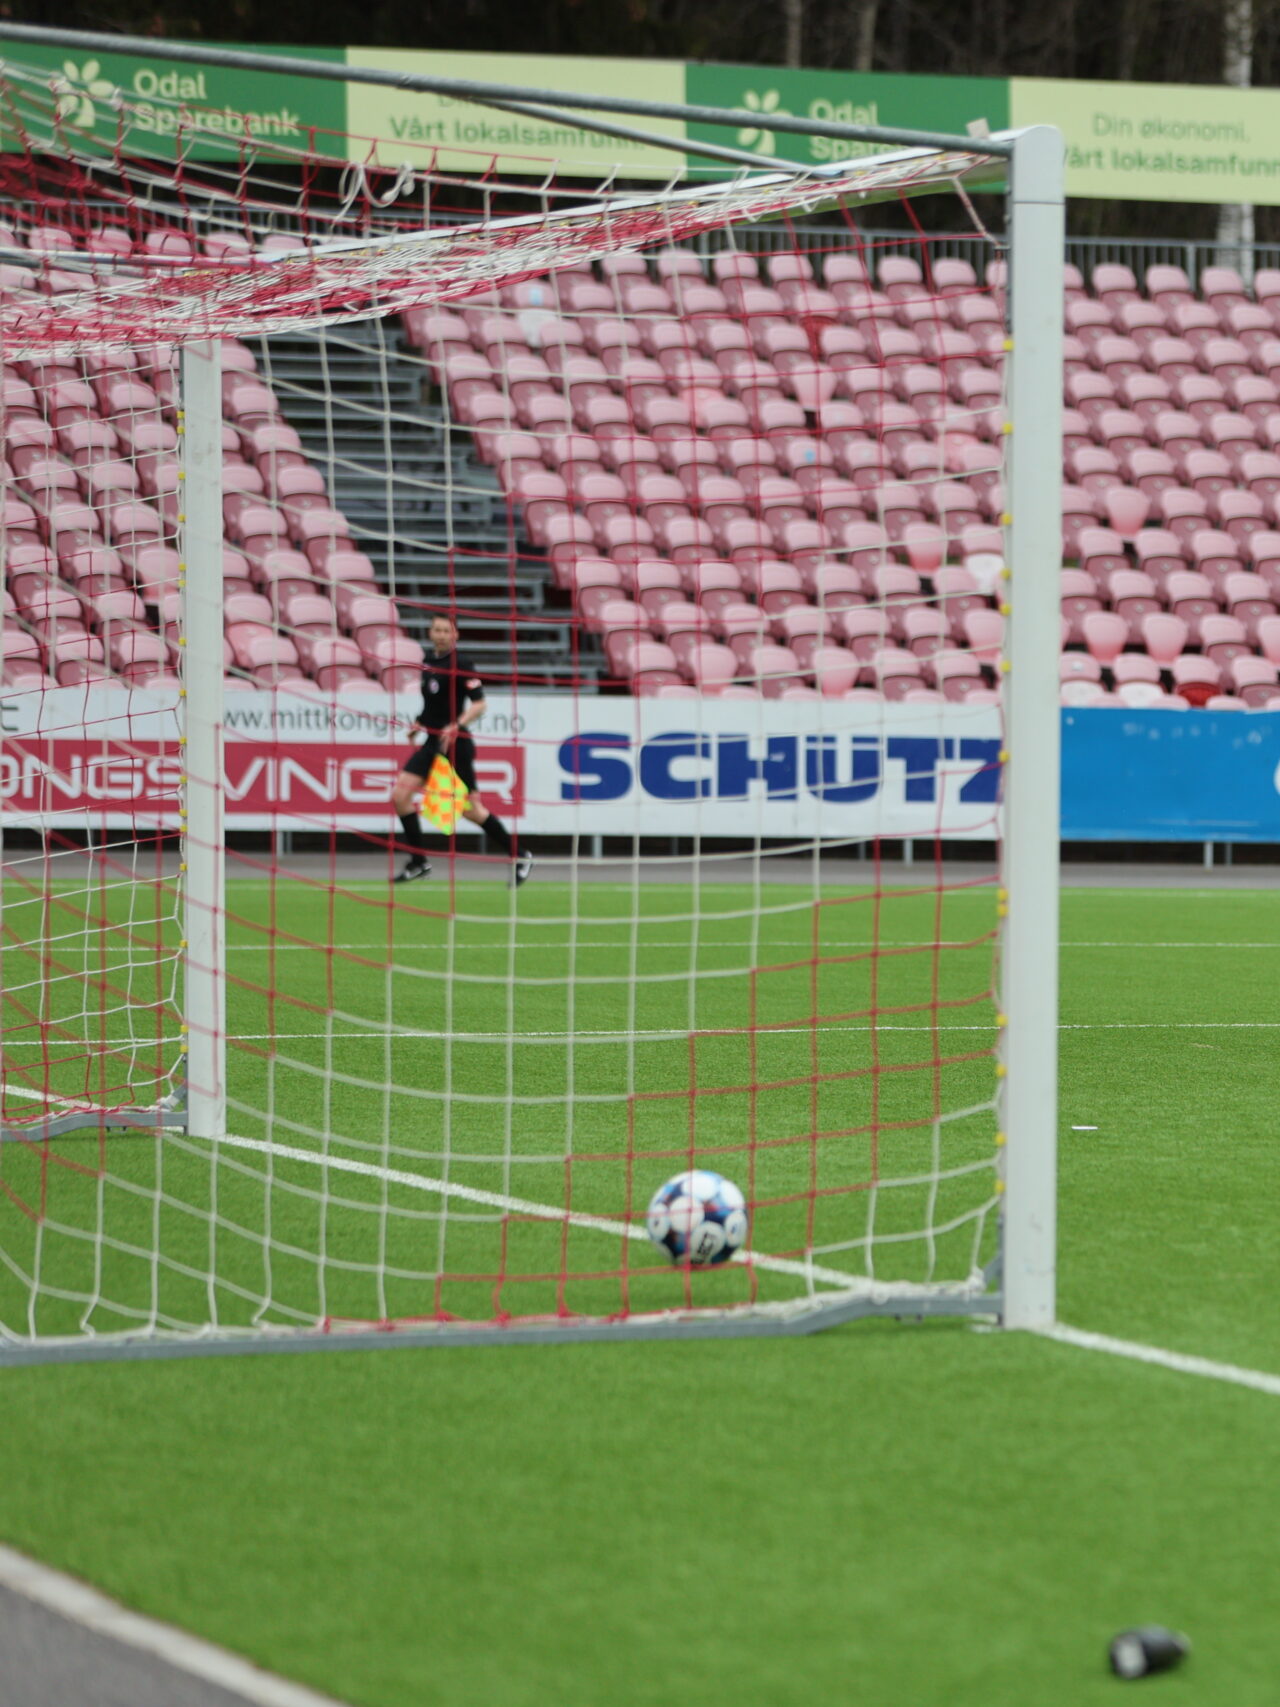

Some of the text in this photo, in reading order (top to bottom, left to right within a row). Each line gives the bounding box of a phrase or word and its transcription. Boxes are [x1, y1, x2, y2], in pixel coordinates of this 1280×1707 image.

[133, 69, 208, 99] Odal
[134, 102, 300, 137] Sparebank
[808, 99, 879, 127] Odal
[390, 115, 446, 142] Vårt
[1092, 112, 1251, 144] Din økonomi.
[1063, 144, 1104, 170] årt
